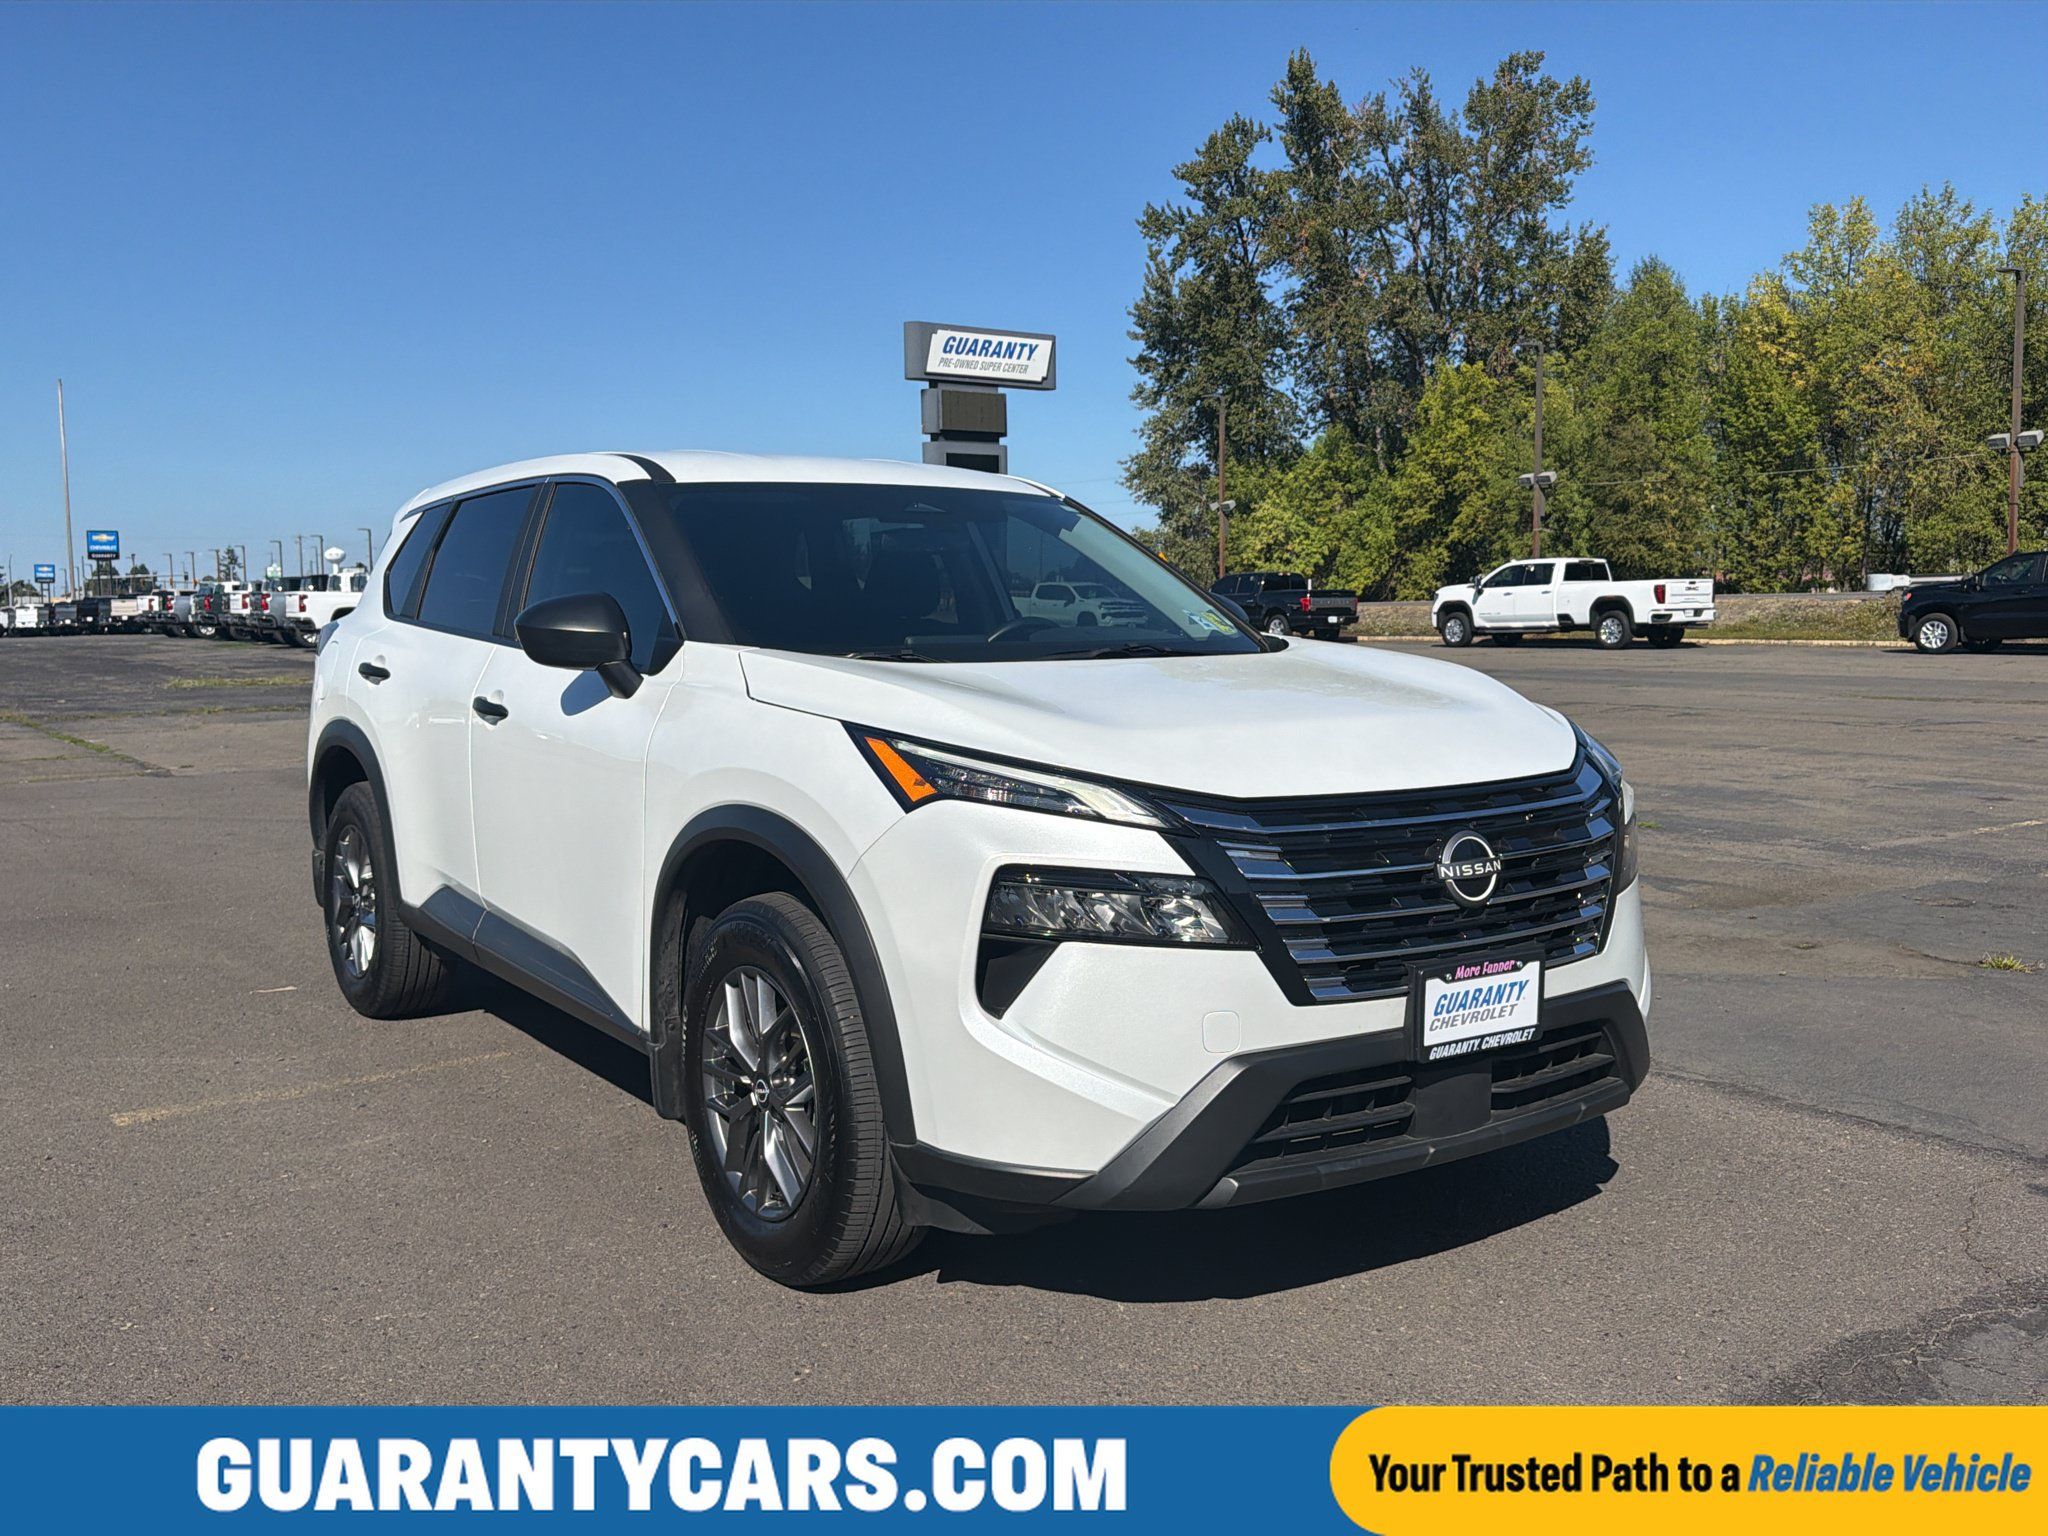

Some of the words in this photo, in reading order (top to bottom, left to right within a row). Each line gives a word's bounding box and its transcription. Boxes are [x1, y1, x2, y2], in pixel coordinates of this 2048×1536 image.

[942, 336, 1039, 361] GUARANTY
[937, 357, 979, 370] PRE-OWNED
[979, 361, 1003, 372] SUPER
[1002, 363, 1029, 375] CENTER
[1440, 859, 1501, 878] NISSAN
[1454, 965, 1480, 980] More
[1433, 979, 1530, 1017] GUARANTY
[1429, 1003, 1518, 1032] CHEVROLET
[1429, 1039, 1479, 1060] GUARANTY
[1481, 1028, 1536, 1050] CHEVROLET
